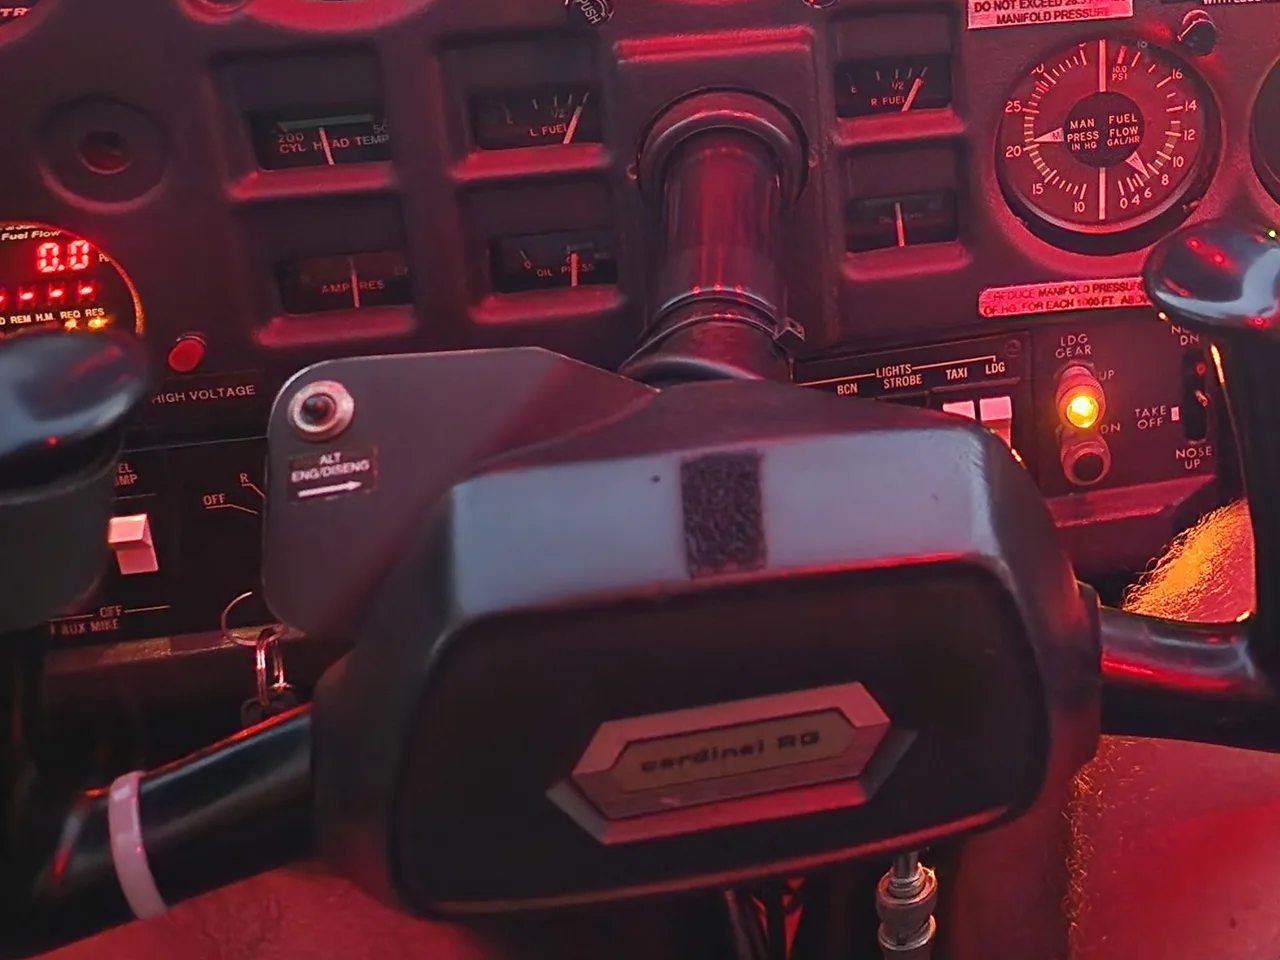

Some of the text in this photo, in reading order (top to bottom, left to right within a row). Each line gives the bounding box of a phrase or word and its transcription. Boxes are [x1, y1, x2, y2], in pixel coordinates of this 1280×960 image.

[974, 1, 991, 12] DO
[994, 0, 1018, 11] NOT
[996, 11, 1051, 25] MANIFOLD
[1070, 118, 1095, 129] MAN
[1109, 113, 1138, 124] FUEL
[1067, 131, 1099, 142] PRESS
[1109, 126, 1139, 136] FLOW
[1, 230, 61, 241] Fuel Flow
[37, 240, 89, 273] 0.0
[10, 308, 105, 324] REM REQ RES
[1061, 333, 1088, 347] LDG
[1055, 344, 1092, 358] GEAR
[875, 363, 912, 379] LIGHTS
[945, 367, 968, 380] TAXI
[985, 361, 1005, 375] LDG
[883, 373, 923, 389] STROBE
[188, 384, 256, 402] VOLTAGE
[837, 383, 858, 396] BCN
[1135, 405, 1168, 418] TAKE
[1137, 418, 1164, 430] OFF
[1175, 446, 1212, 459] NOSE
[1184, 458, 1201, 469] UP
